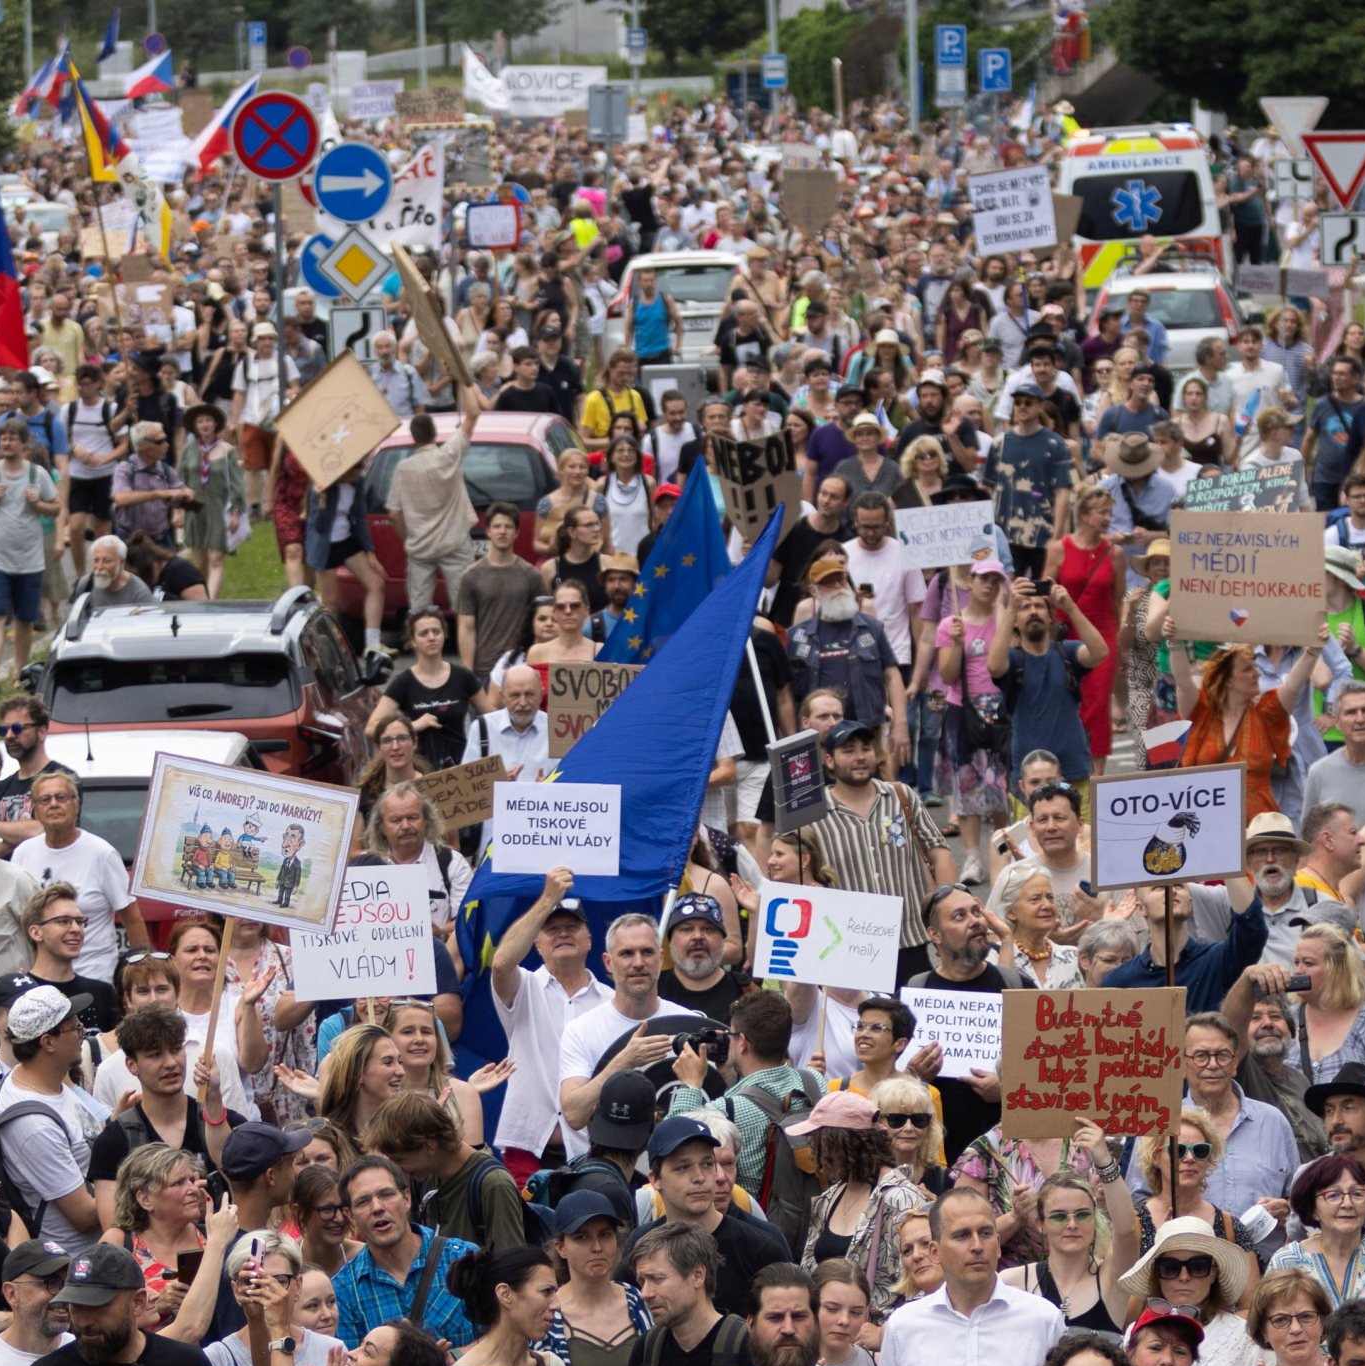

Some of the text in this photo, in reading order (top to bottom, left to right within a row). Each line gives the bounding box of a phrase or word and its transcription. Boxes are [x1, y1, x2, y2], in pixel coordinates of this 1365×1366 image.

[989, 54, 1005, 79] P
[506, 72, 582, 90] OVICE
[1087, 155, 1184, 171] AMBULANCE
[1189, 478, 1213, 491] KDO
[1178, 527, 1300, 549] BEZ NEZÁVISLÝCH
[1191, 548, 1260, 575] MÉDIÍ
[1179, 576, 1323, 599] NENÍ DEMOKRACIE
[551, 668, 639, 702] SVOBO
[472, 780, 487, 792] NE
[188, 784, 323, 823] VÍŠ CO, ANDREJI? JDI DO MARKÍZY!
[506, 797, 609, 813] MÉDIA NEJSOU
[1110, 786, 1226, 816] OTO-VÍCE
[527, 814, 587, 830] TISKOVÉ
[502, 831, 612, 848] ODDĚLNÍ VLÁDY
[370, 920, 425, 941] ODDĚLENÍ
[329, 947, 397, 980] VLÁDY
[847, 943, 879, 964] maily
[913, 996, 1002, 1013] MÉDIA NEPAT
[1036, 992, 1143, 1031] Bude nutné
[926, 1014, 1002, 1028] POLITIKŮM.
[928, 1030, 940, 1041] SI
[944, 1031, 962, 1042] TO
[1024, 1035, 1093, 1061] stavět
[1038, 1058, 1164, 1092] když politici
